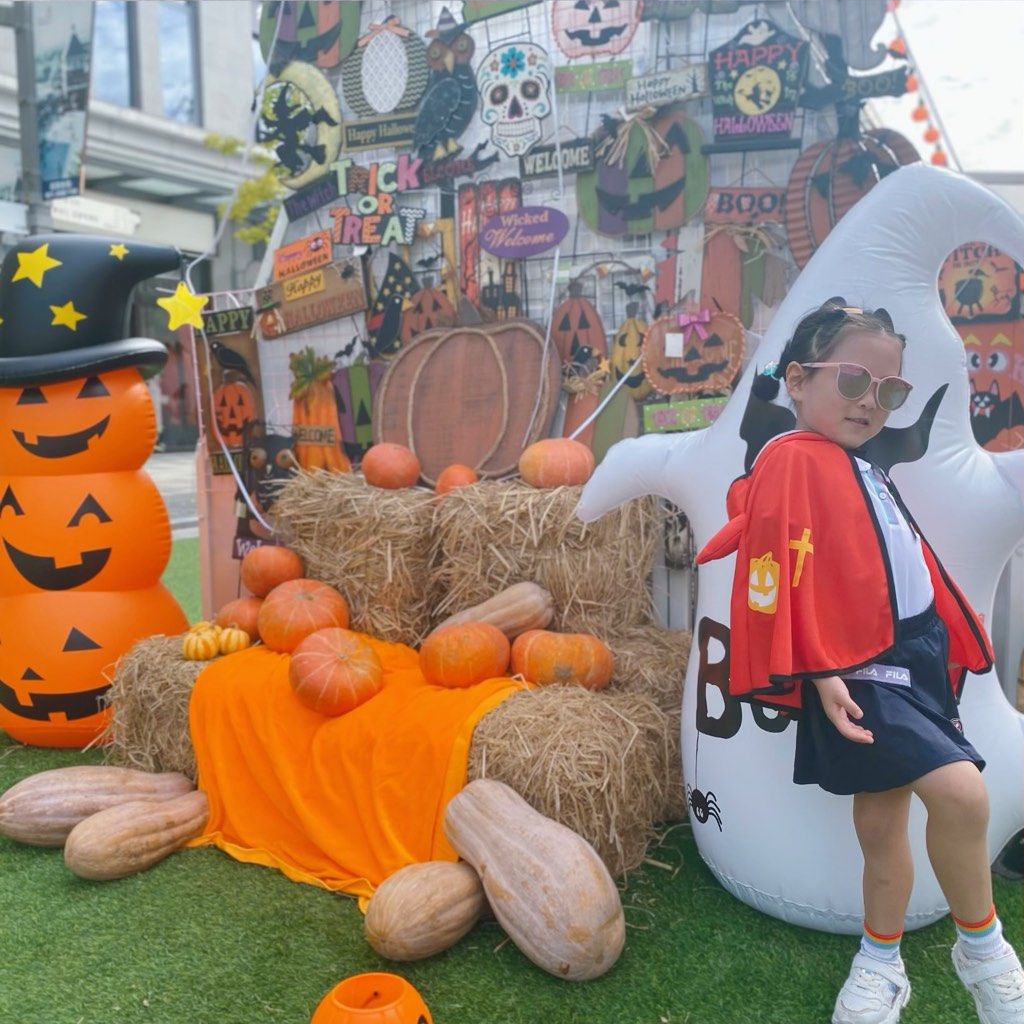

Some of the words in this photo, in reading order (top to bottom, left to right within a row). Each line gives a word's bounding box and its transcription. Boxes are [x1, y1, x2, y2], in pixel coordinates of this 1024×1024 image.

[714, 40, 804, 71] HAPPY
[523, 144, 590, 176] WELCOME
[329, 153, 423, 196] TRICK
[357, 193, 394, 216] OR
[329, 207, 426, 246] TREAT
[501, 210, 549, 227] Wicked
[483, 226, 556, 249] Welcome
[285, 273, 322, 297] Happy
[206, 308, 250, 333] APPY
[886, 670, 910, 681] FILA
